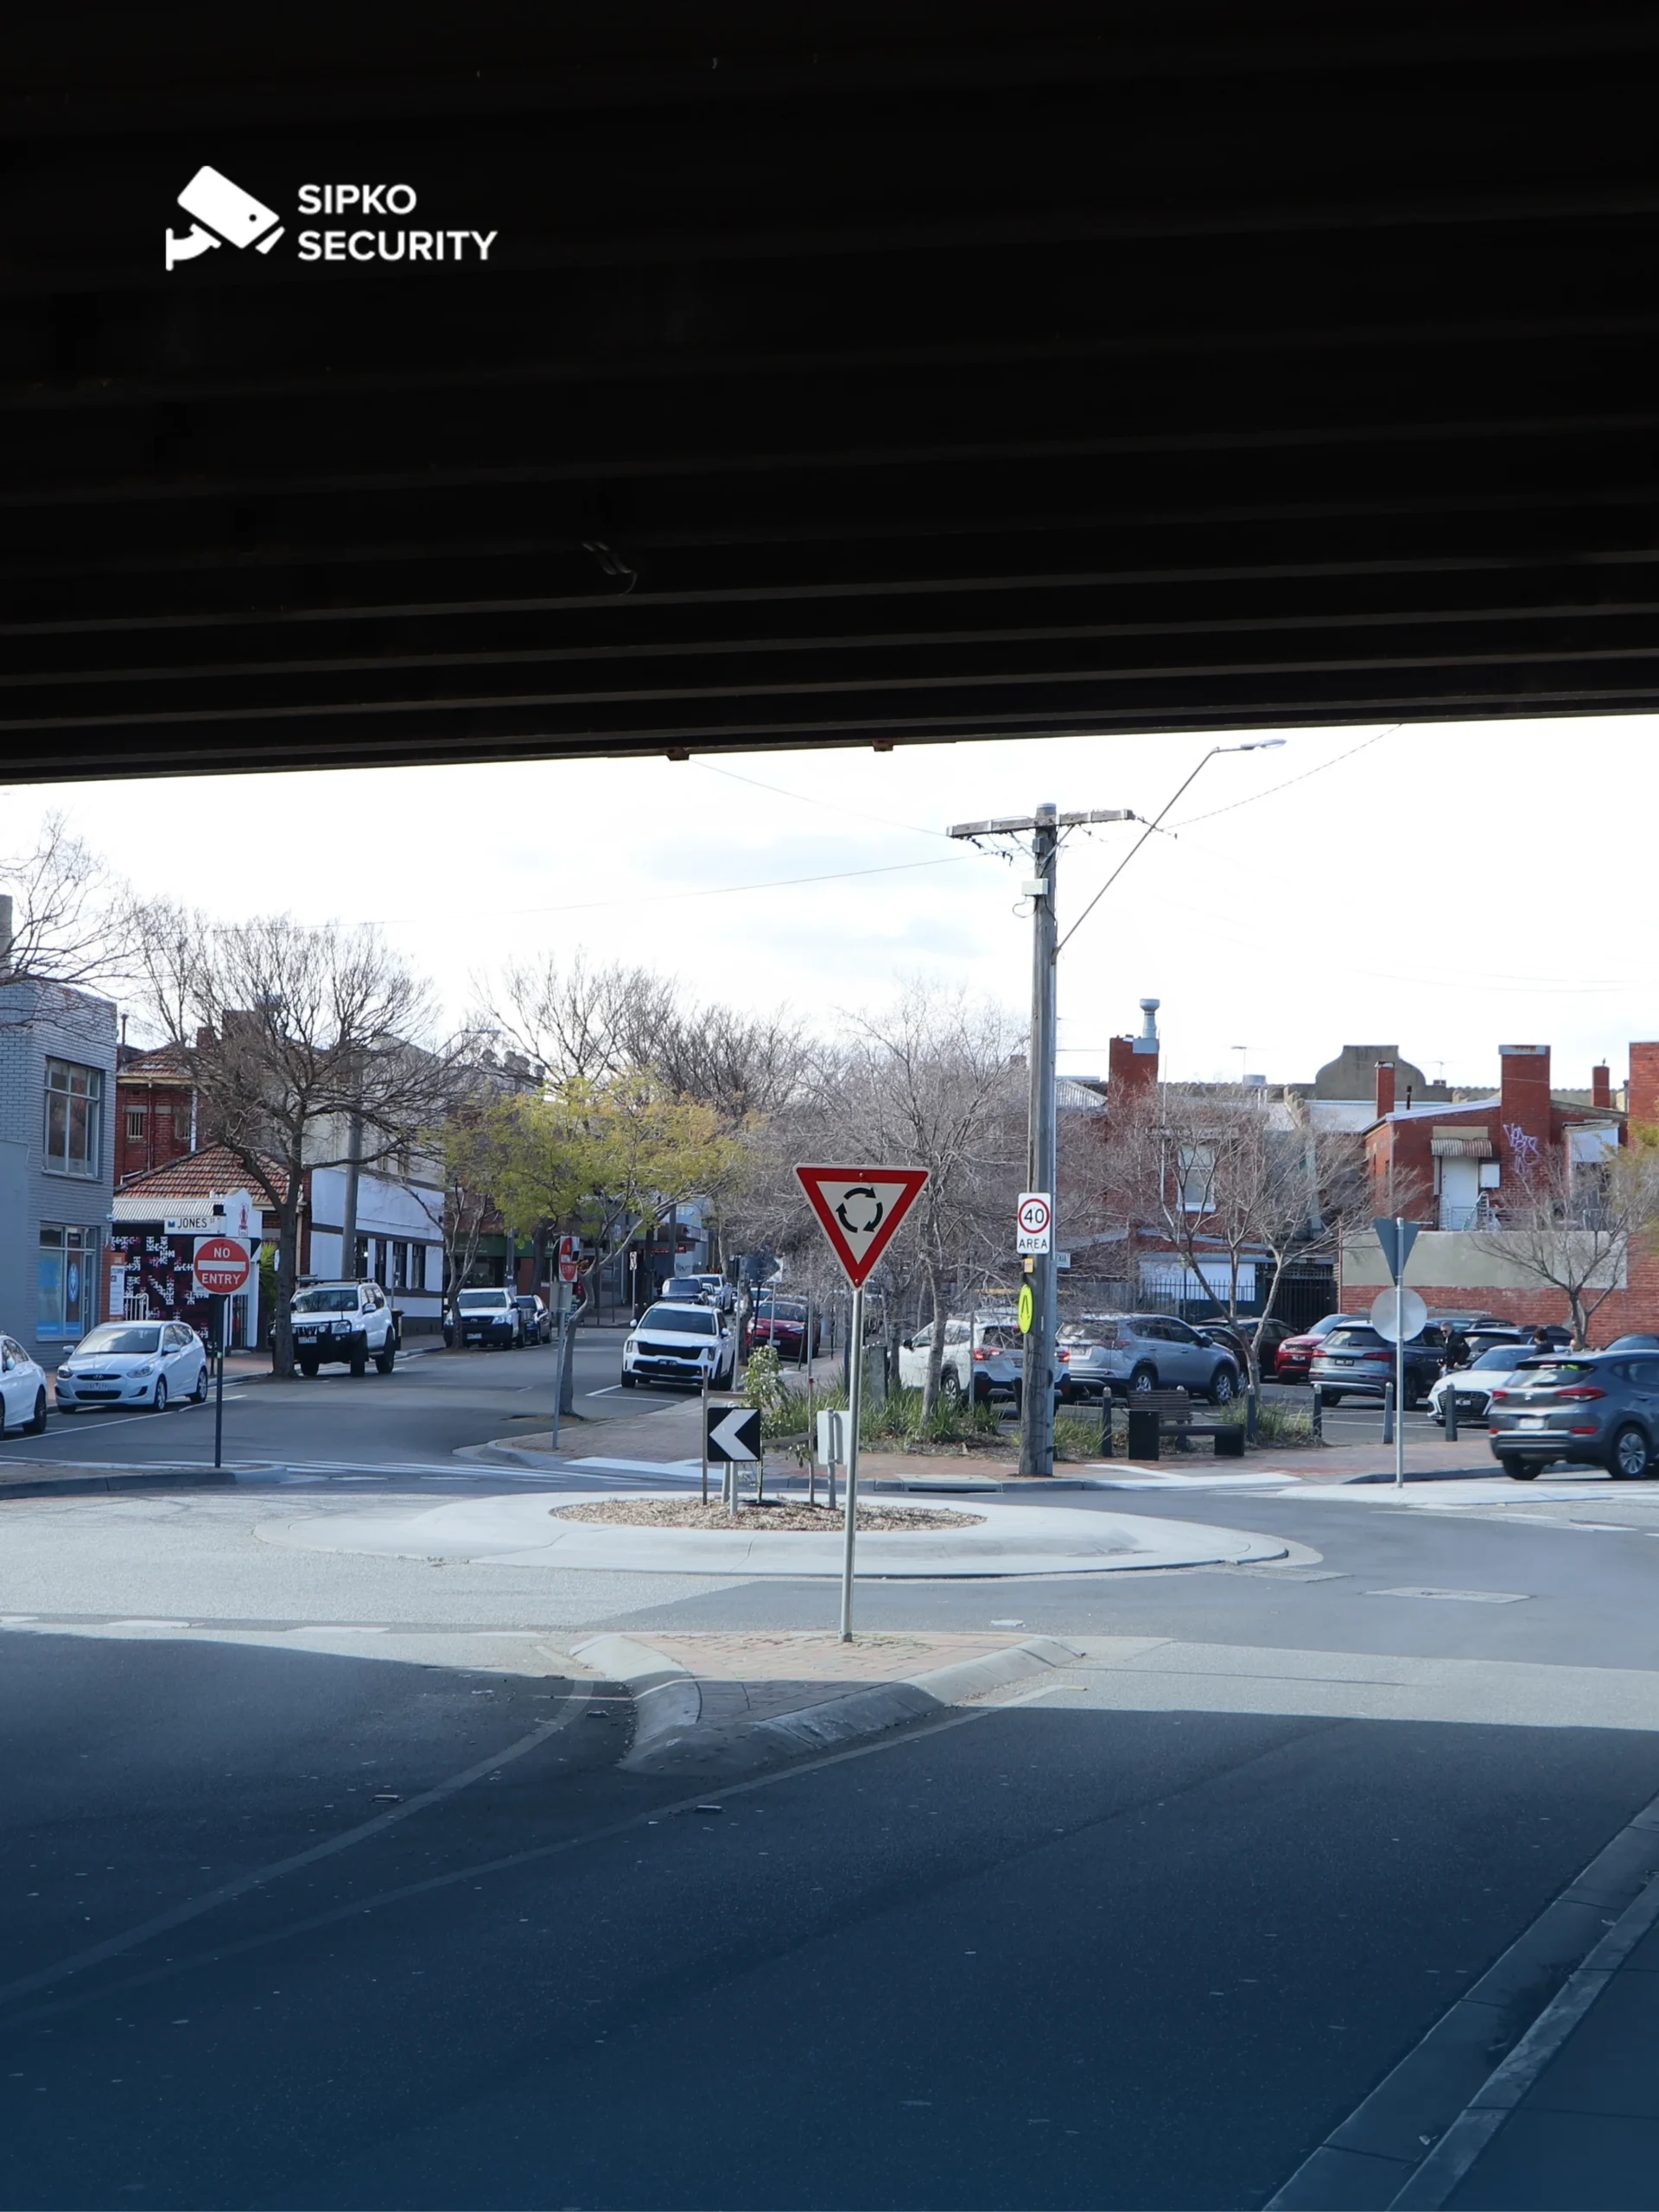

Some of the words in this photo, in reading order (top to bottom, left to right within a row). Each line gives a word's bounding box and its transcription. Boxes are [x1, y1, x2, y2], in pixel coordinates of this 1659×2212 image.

[1024, 1208, 1045, 1224] 40
[177, 1217, 207, 1228] JONES
[1019, 1238, 1048, 1249] AREA
[213, 1247, 231, 1258] NO
[201, 1273, 241, 1285] ENTRY
